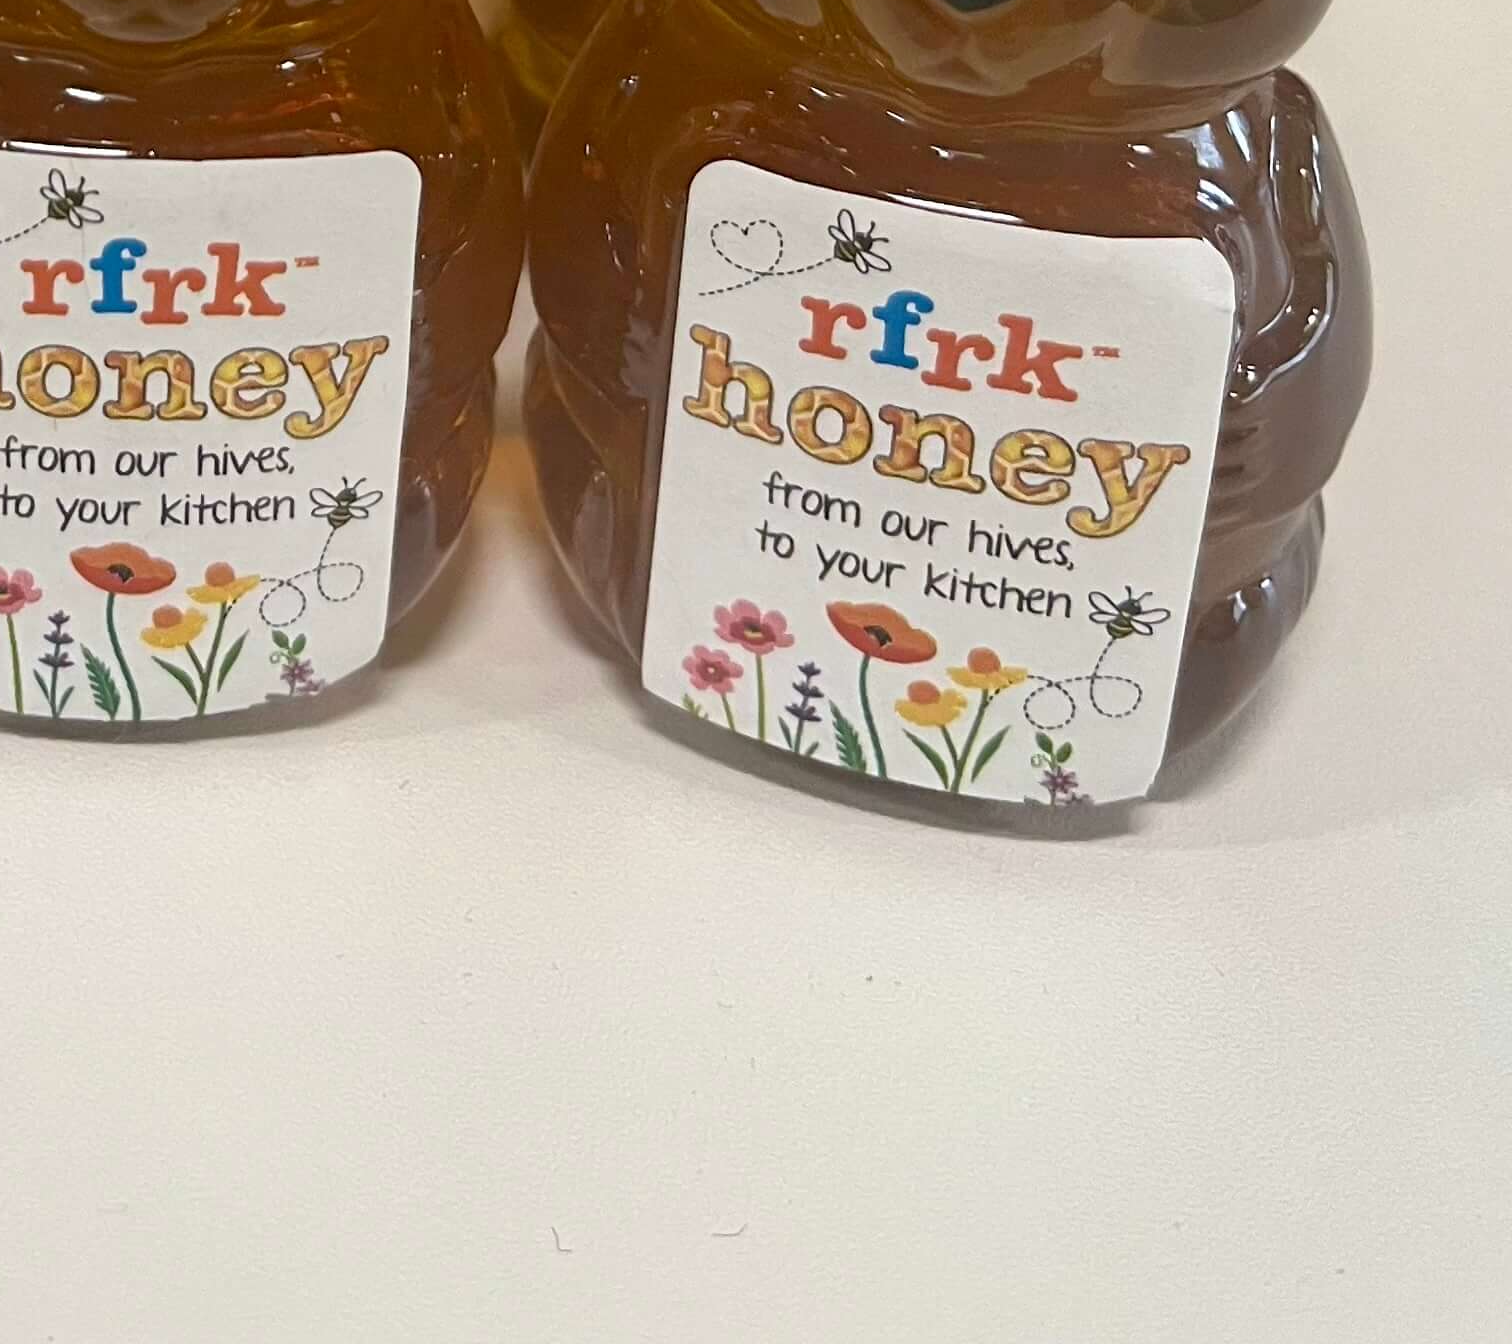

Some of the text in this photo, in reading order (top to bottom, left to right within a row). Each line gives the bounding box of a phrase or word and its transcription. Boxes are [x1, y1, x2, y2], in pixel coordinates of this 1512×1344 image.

[0, 435, 295, 478] from our hives,
[682, 323, 1191, 539] honey
[55, 495, 142, 531] your
[161, 492, 295, 526] kitchen
[762, 471, 1075, 573] from our hives,
[755, 520, 1073, 620] to your kitchen
